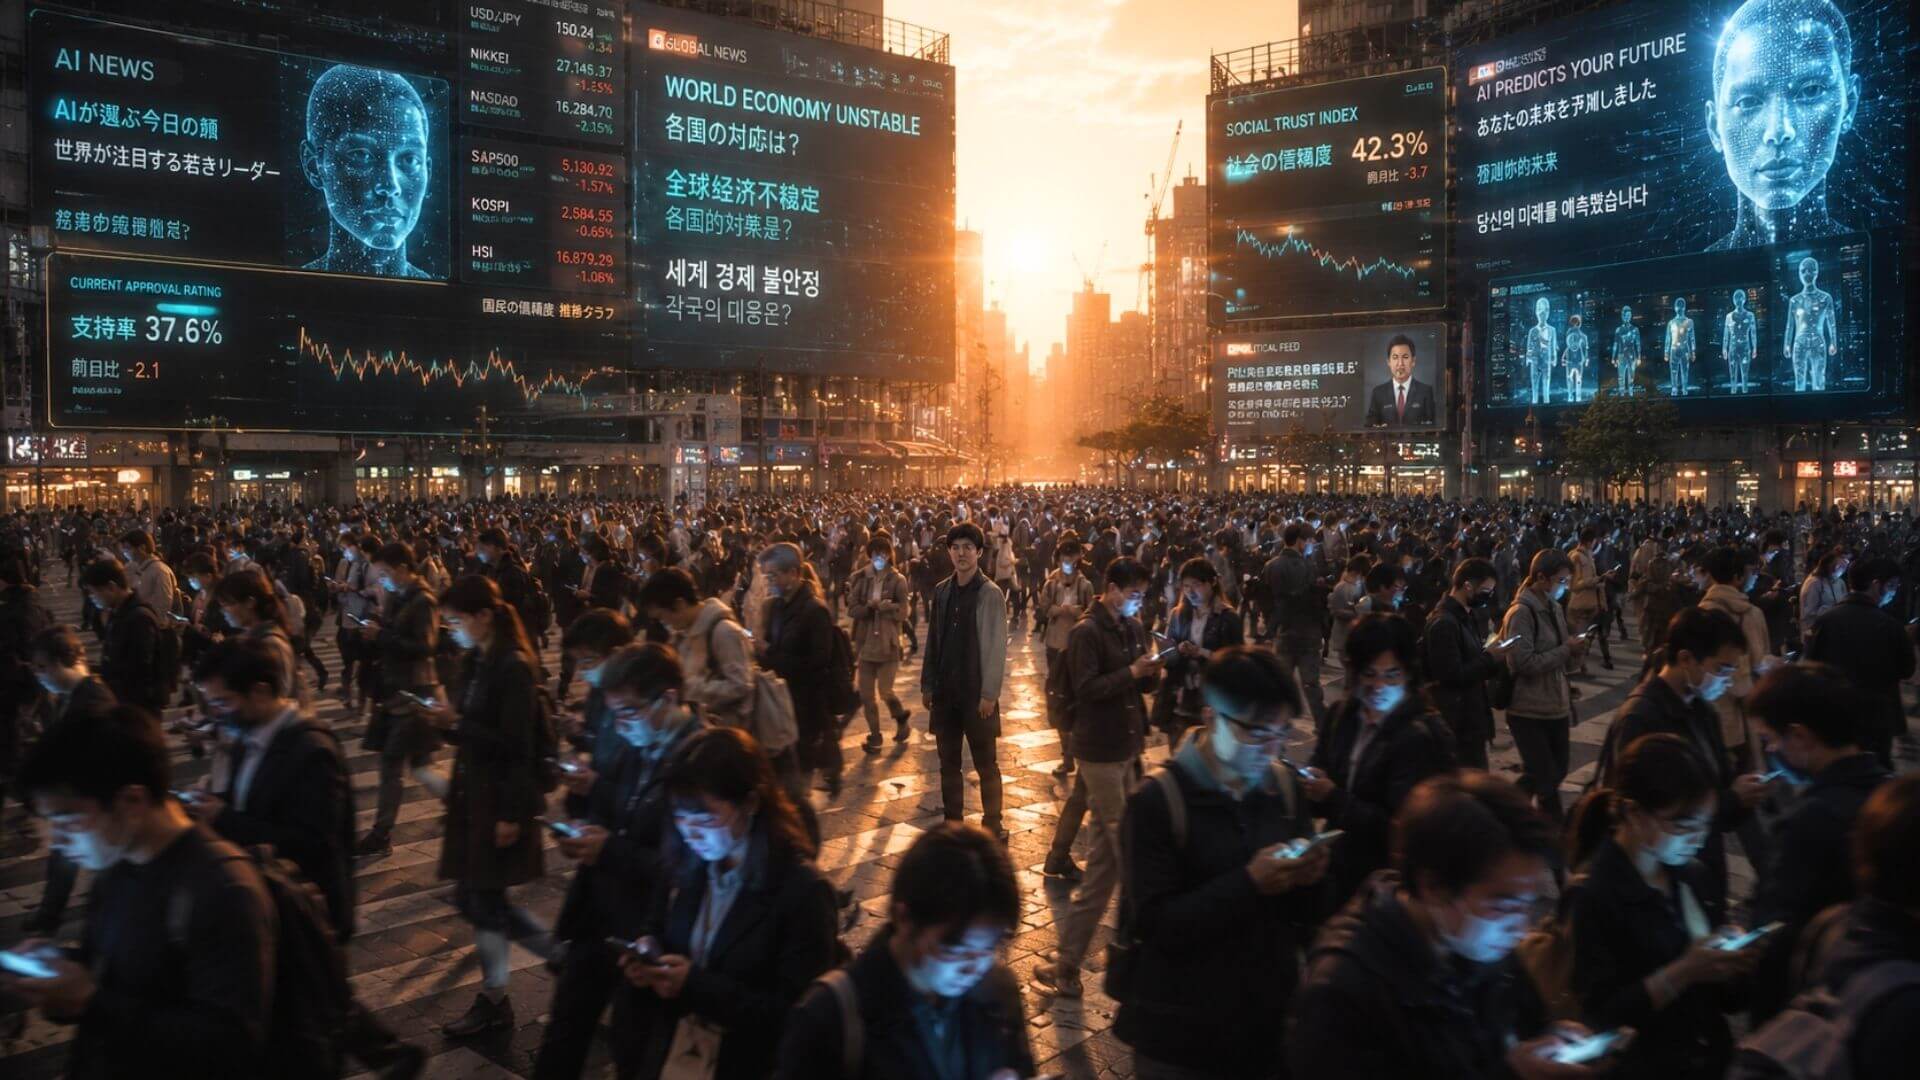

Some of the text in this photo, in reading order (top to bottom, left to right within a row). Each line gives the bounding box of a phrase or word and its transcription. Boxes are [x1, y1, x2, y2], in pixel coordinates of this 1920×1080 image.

[470, 6, 521, 26] USD/JPY
[556, 21, 594, 39] 150.24
[470, 48, 509, 64] NIKKEI
[665, 37, 747, 63] GLOBAL NEWS
[55, 48, 154, 81] AI NEWS
[1477, 84, 1490, 102] AI
[1496, 64, 1566, 98] PREDICTS
[1570, 52, 1614, 79] YOUR
[1619, 33, 1686, 66] FUTURE
[665, 74, 921, 136] WORLD ECONOMY UNSTABLE
[1226, 106, 1359, 137] SOCIAL TRUST INDEX
[54, 138, 280, 181] 世界が注目する若きリーダー
[1352, 130, 1428, 163] 42.3%
[1404, 165, 1428, 180] -3.7
[472, 197, 509, 213] KOSPI
[1477, 208, 1514, 234] 당신의
[472, 245, 493, 258] HSI
[70, 277, 222, 298] CURRENT APPROVAL RATING
[716, 262, 755, 293] 경제
[762, 265, 820, 297] 불안정
[71, 314, 222, 344] 支持率 37.6%
[1280, 342, 1300, 352] FEED
[127, 361, 161, 379] -2.1
